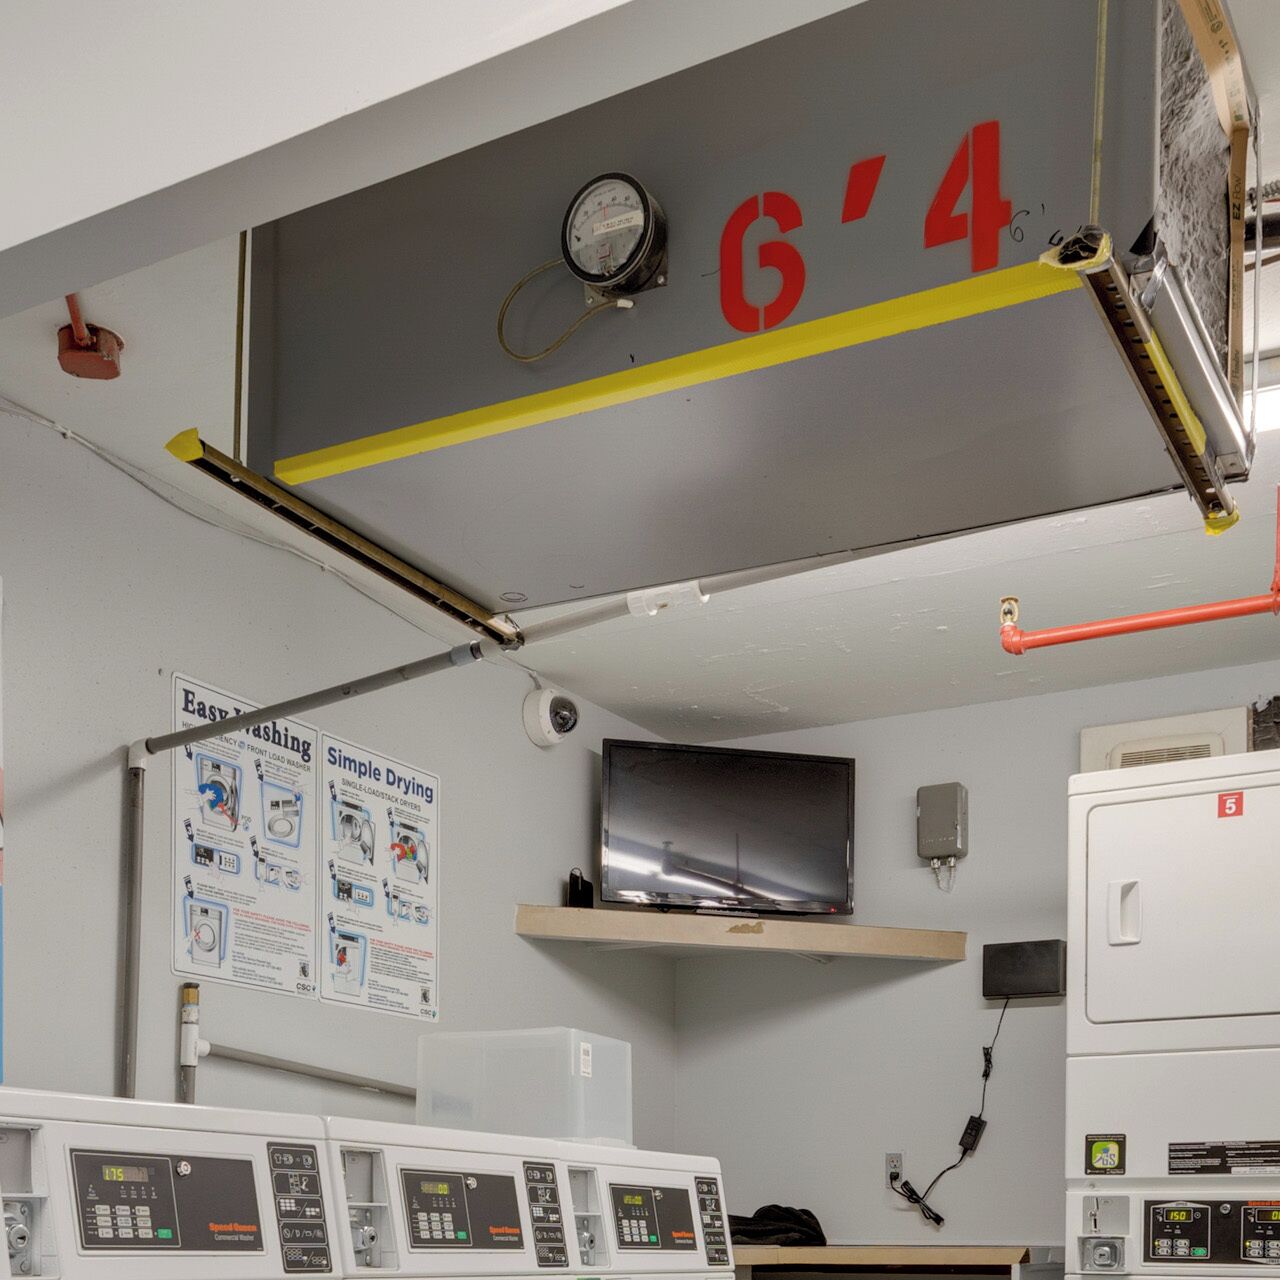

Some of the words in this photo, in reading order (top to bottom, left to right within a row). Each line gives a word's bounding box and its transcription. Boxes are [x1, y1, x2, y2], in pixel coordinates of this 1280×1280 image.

[1233, 203, 1240, 220] EZ
[247, 744, 268, 757] FRONT
[269, 751, 286, 764] LOAD
[286, 759, 311, 773] WASHER
[328, 746, 381, 781] Simple
[386, 768, 433, 804] Drying
[400, 798, 421, 812] DRYERS
[1224, 798, 1236, 814] 5
[296, 982, 311, 992] CSC
